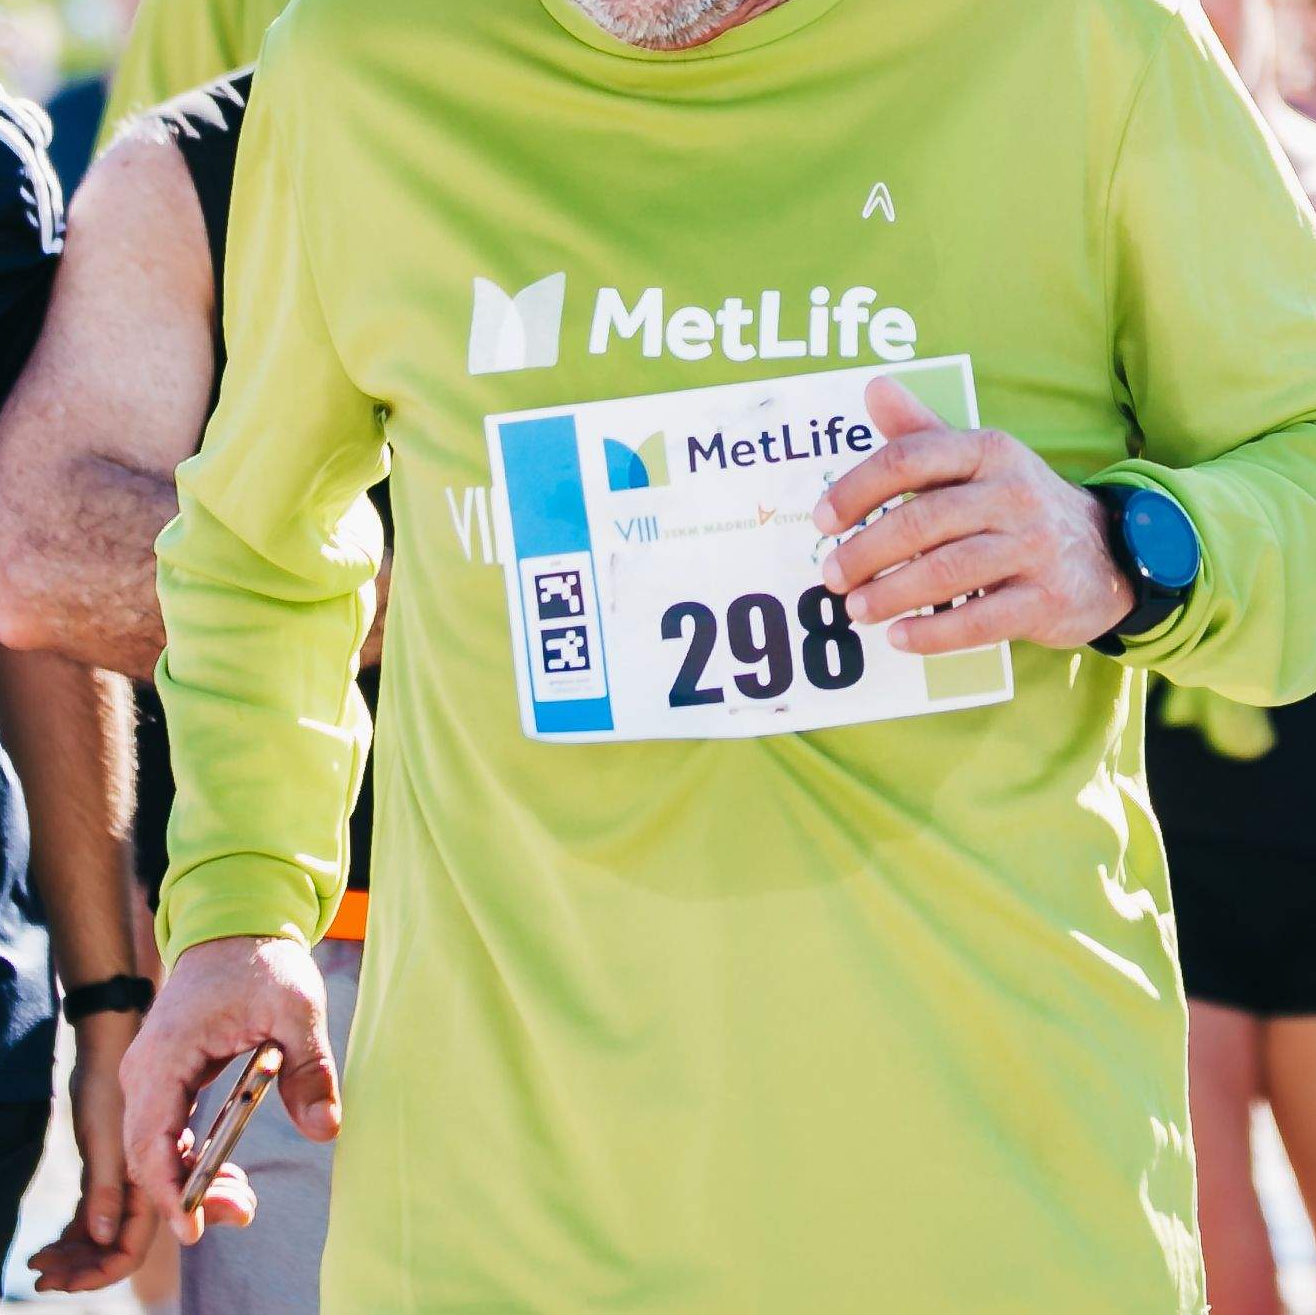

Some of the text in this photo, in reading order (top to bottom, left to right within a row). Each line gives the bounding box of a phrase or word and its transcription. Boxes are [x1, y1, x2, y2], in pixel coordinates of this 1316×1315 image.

[589, 286, 917, 362] MetLife
[687, 416, 873, 472] MetLife
[614, 516, 659, 543] VIII
[704, 519, 757, 534] MADRID
[660, 584, 865, 708] 298
